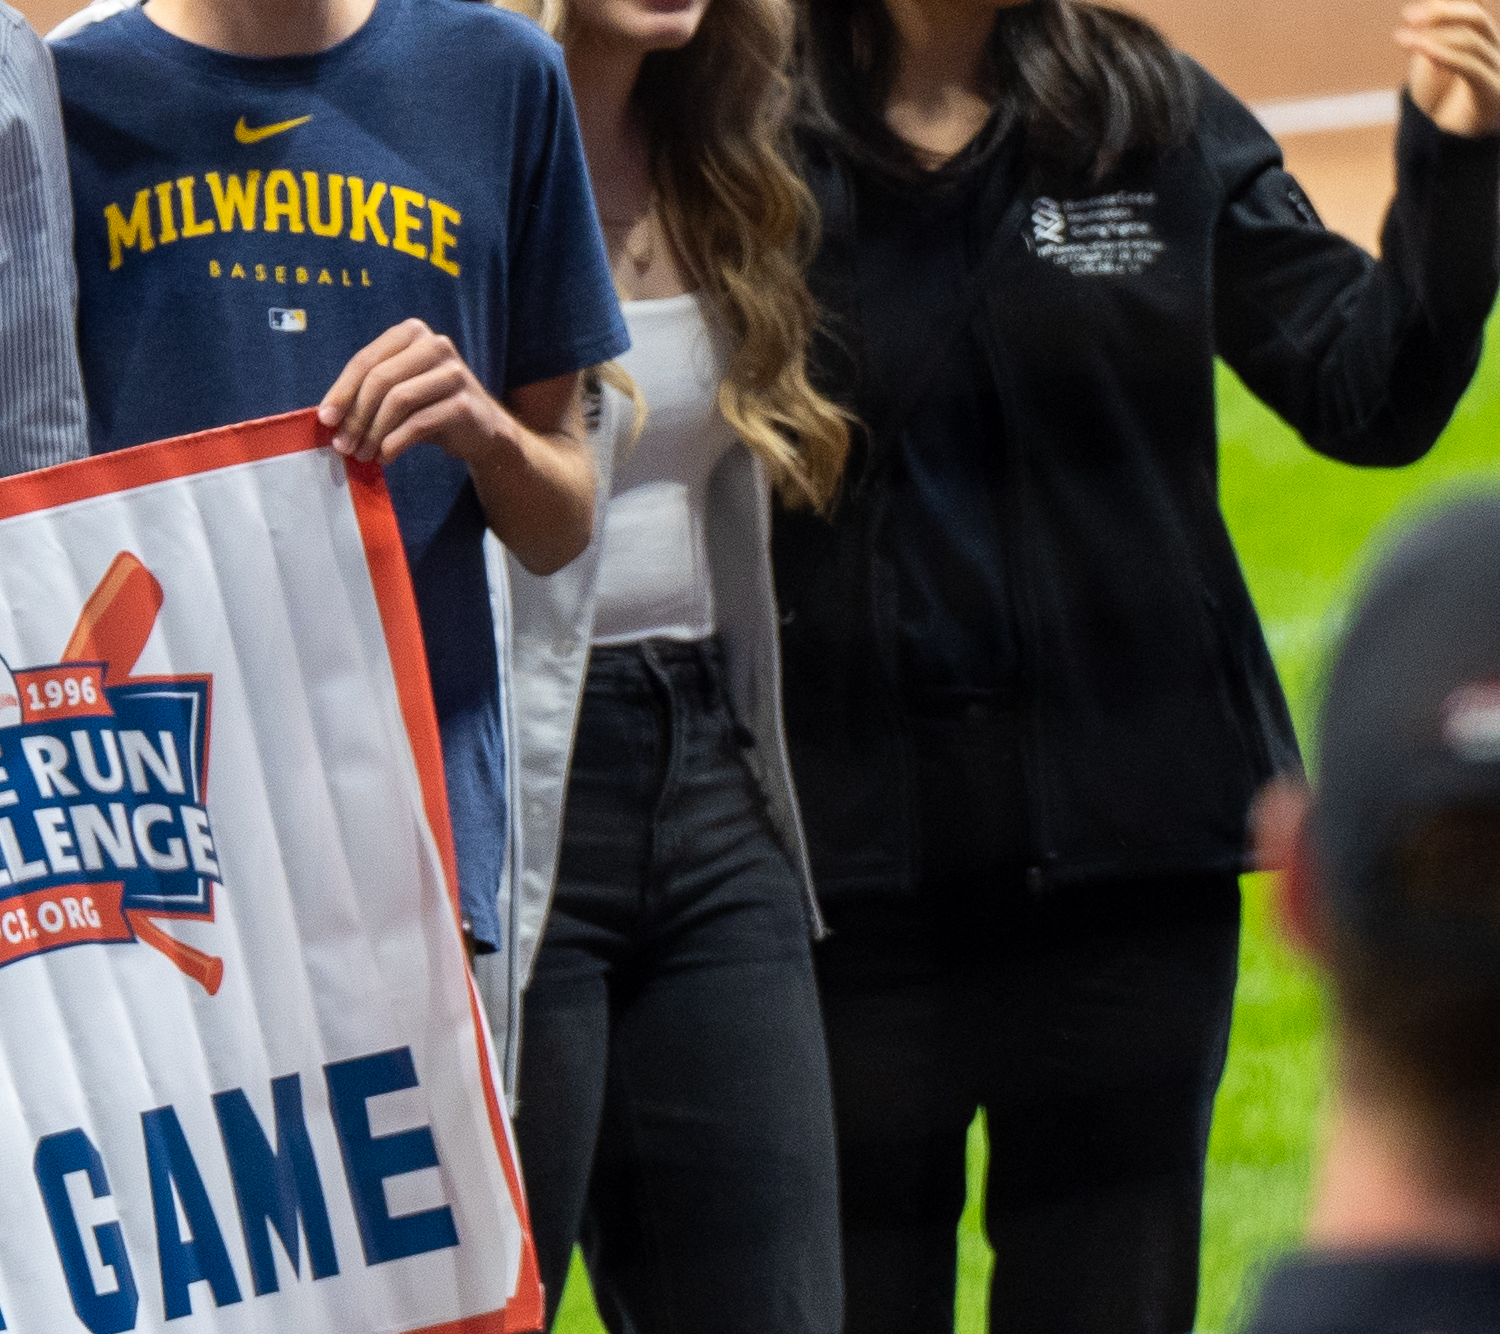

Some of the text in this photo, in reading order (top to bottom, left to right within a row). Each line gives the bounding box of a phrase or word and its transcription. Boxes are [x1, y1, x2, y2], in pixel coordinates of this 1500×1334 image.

[104, 169, 462, 277] MILWAUKEE
[208, 260, 372, 287] BASEBALL
[26, 676, 97, 711] 1996
[20, 728, 187, 799] RUN
